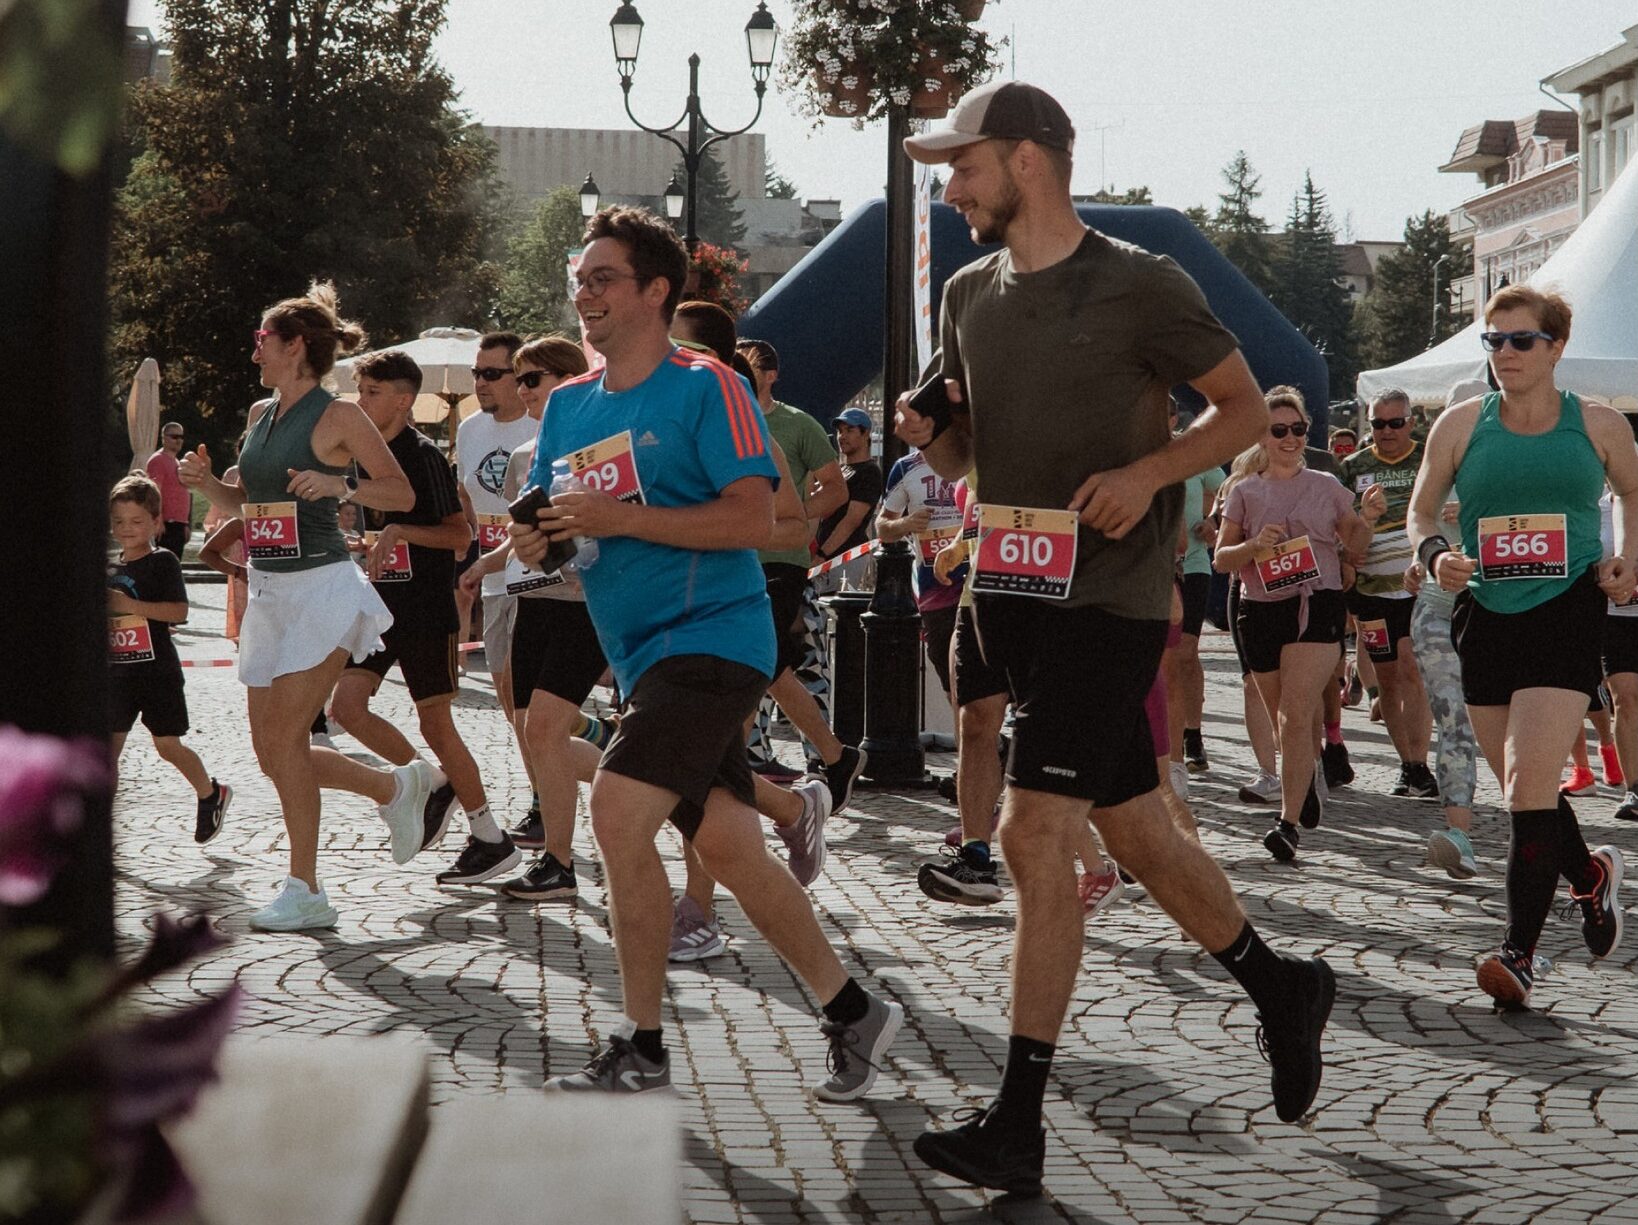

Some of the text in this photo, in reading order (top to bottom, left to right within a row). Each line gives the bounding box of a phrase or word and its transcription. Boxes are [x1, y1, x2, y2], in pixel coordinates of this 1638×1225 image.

[583, 463, 619, 491] 09
[250, 519, 284, 540] 542
[485, 527, 507, 542] 54
[1000, 533, 1053, 567] 610
[1495, 533, 1549, 558] 566
[1269, 552, 1301, 575] 567
